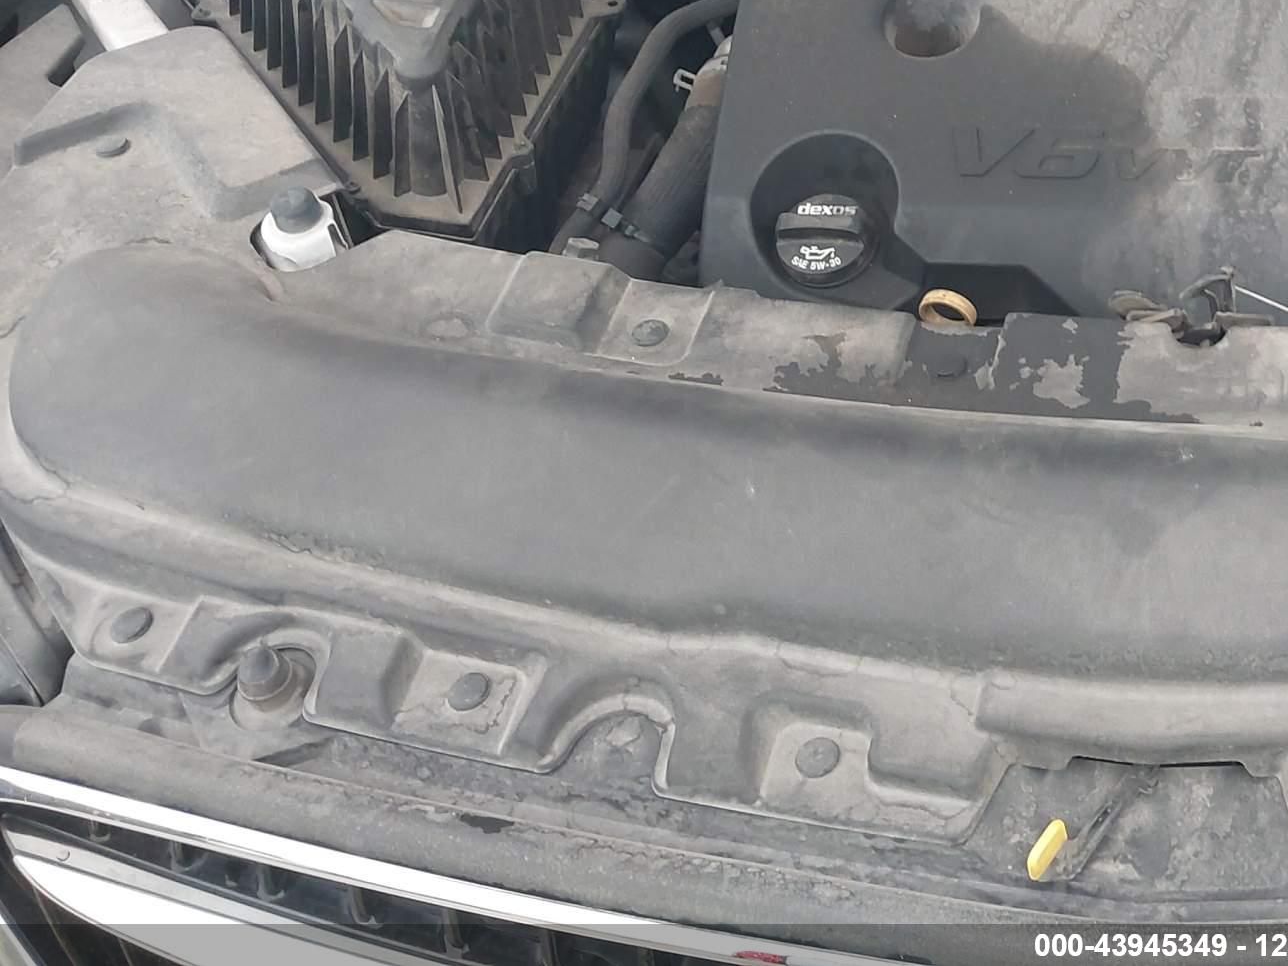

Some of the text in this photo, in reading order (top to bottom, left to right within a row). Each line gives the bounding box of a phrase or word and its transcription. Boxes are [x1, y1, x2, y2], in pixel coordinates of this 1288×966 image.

[797, 202, 859, 216] dexos
[791, 256, 842, 271] SAE 5W-30
